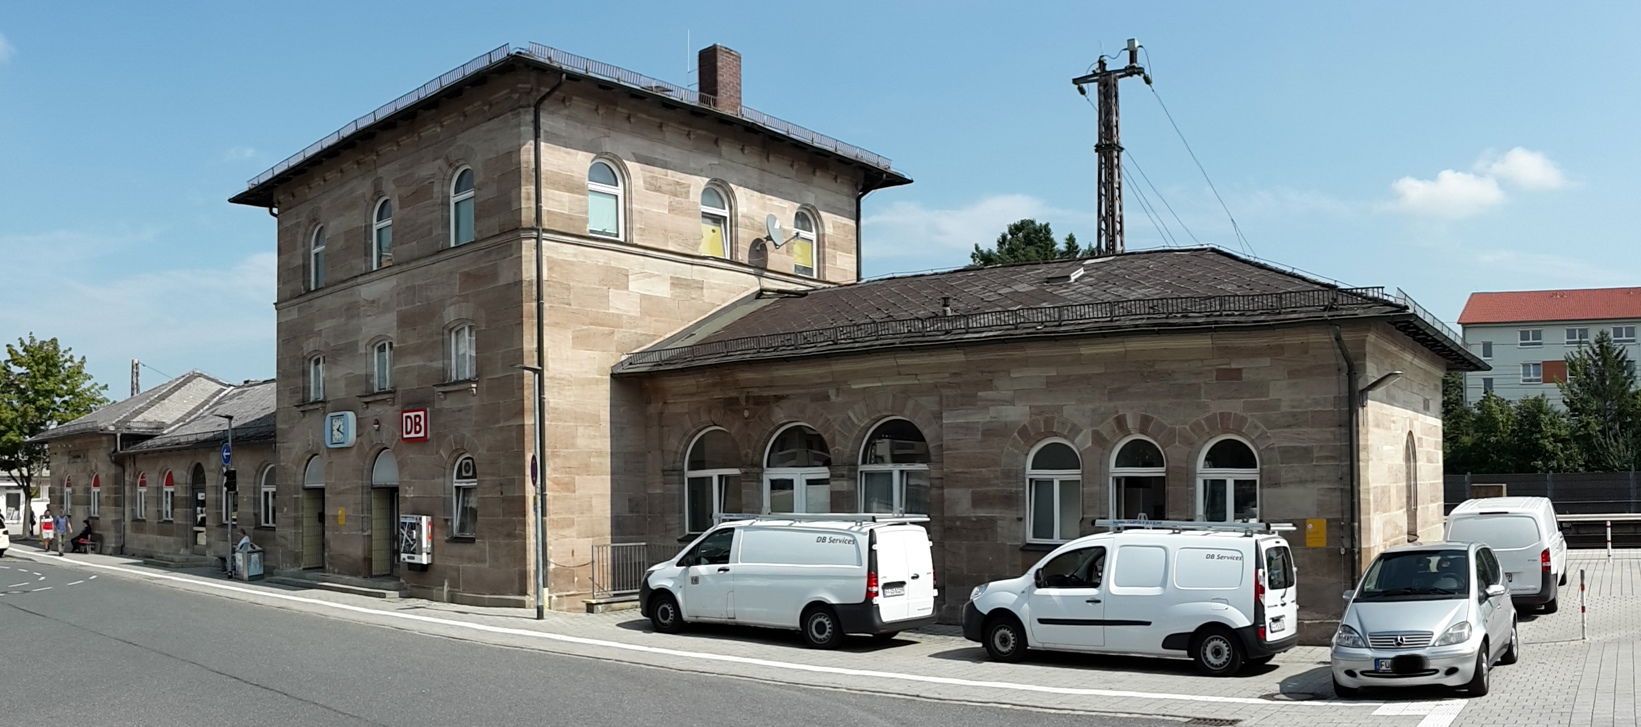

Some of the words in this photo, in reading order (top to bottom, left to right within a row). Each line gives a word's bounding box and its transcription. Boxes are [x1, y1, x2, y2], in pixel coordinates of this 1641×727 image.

[405, 414, 422, 435] DB
[828, 536, 857, 545] Services
[1216, 553, 1243, 561] Services
